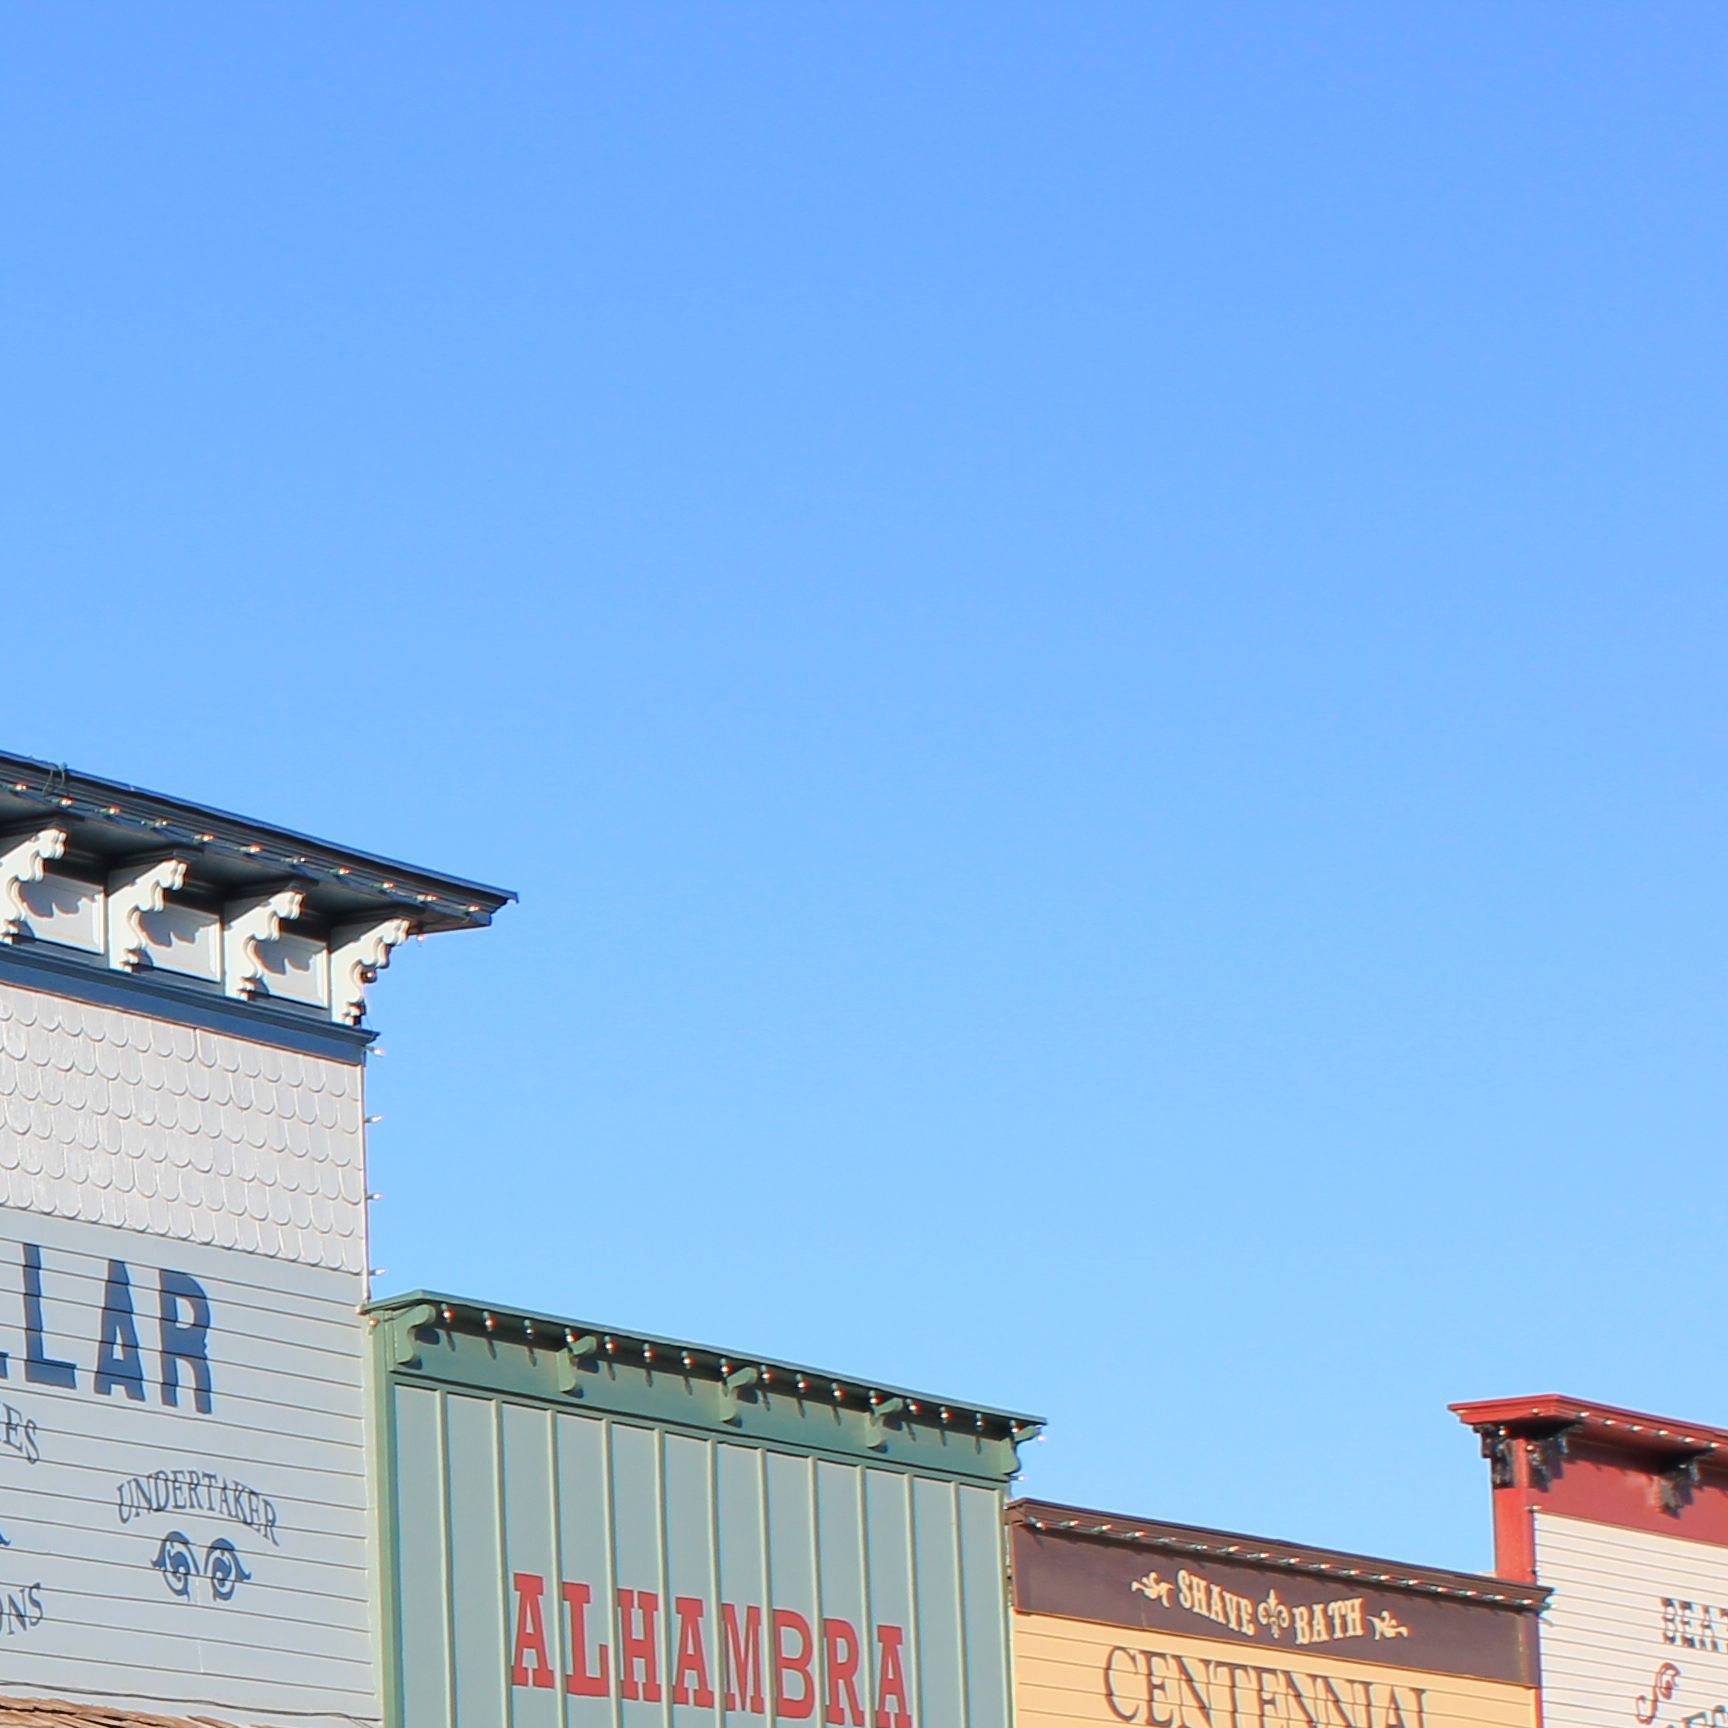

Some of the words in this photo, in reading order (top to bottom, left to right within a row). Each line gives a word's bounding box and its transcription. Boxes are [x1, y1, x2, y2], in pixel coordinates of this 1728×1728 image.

[116, 1470, 278, 1545] UNDERTAKER
[1177, 1569, 1256, 1636] SHAVE
[1292, 1598, 1364, 1645] BATH
